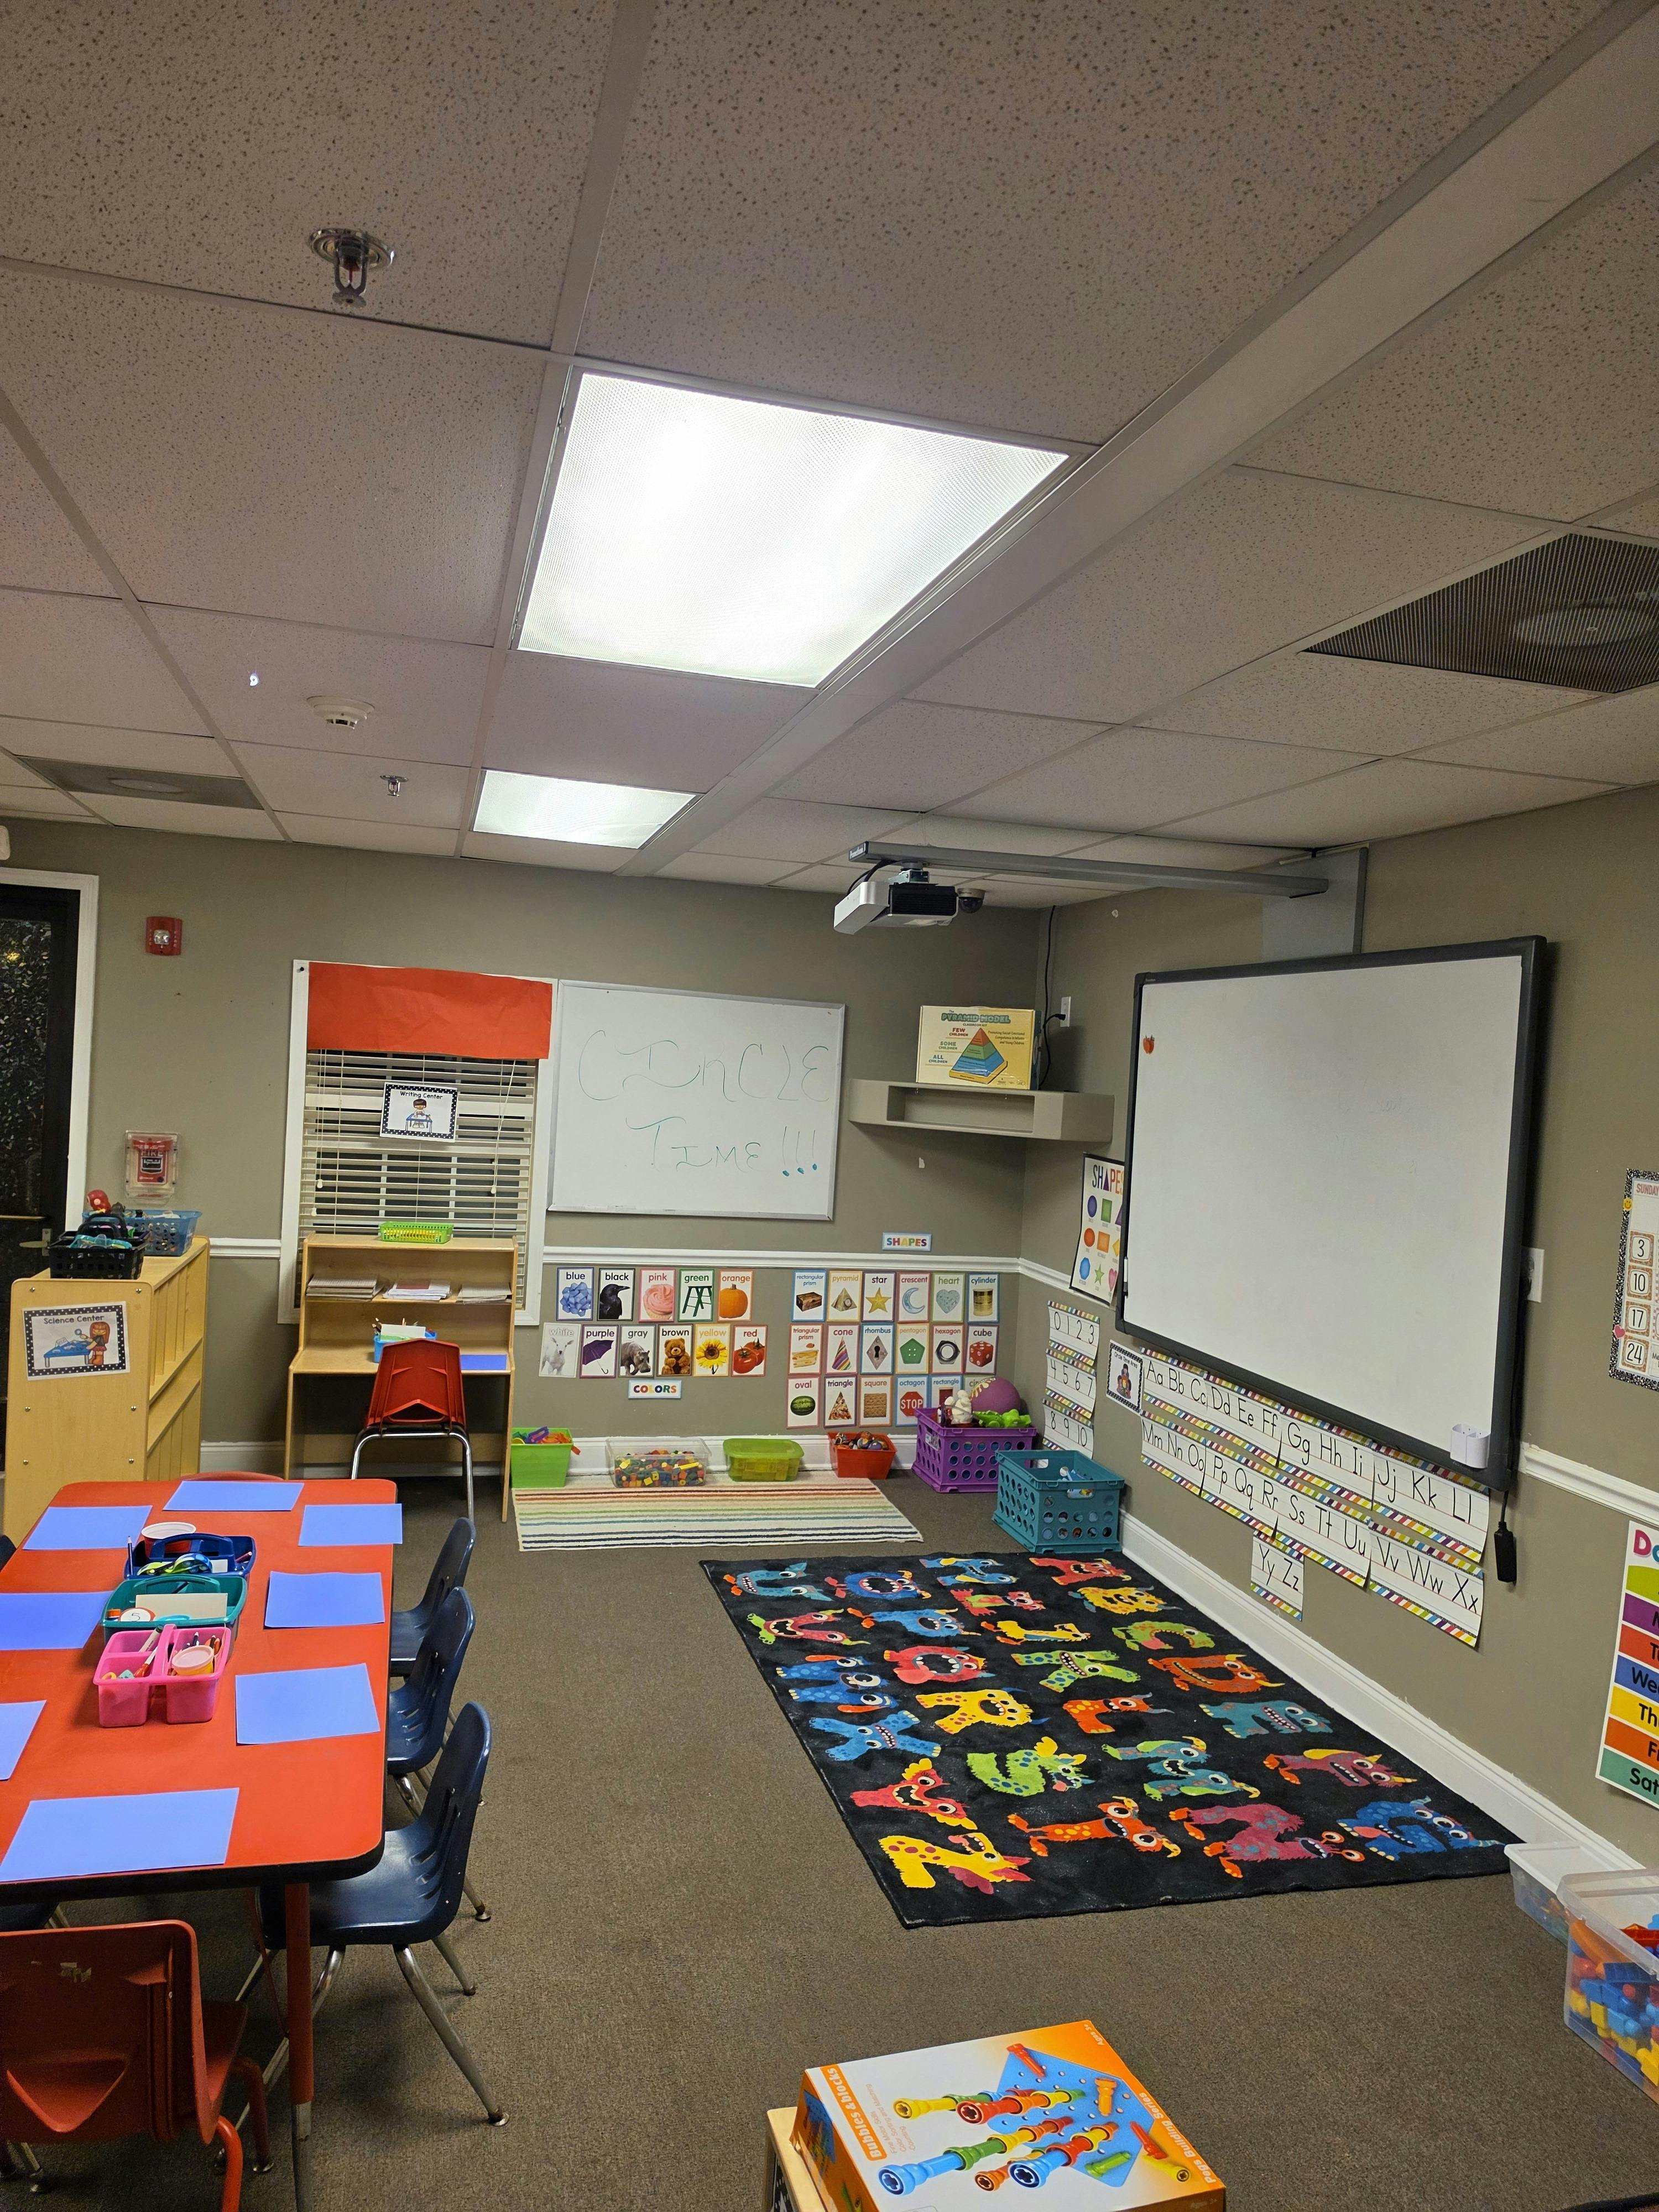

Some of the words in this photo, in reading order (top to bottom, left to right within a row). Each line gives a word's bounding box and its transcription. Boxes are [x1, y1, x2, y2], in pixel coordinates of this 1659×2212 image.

[941, 1013, 980, 1022] PYRAMID
[980, 1014, 1011, 1024] MODEL
[887, 1238, 927, 1247] SHAPES
[1638, 1239, 1645, 1258] 3
[566, 1272, 585, 1280] blue
[648, 1273, 667, 1283] pink
[685, 1274, 709, 1283] green
[721, 1274, 750, 1284] orange
[971, 1276, 997, 1285] cylinder
[1634, 1273, 1646, 1292] 10
[1632, 1309, 1644, 1328] 17
[549, 1328, 574, 1337] white
[586, 1329, 615, 1338] purple
[628, 1329, 648, 1338] gray
[699, 1329, 727, 1337] yellow
[1054, 1311, 1061, 1331] 0
[1067, 1315, 1070, 1335] 1
[1076, 1319, 1082, 1340] 2
[1088, 1324, 1094, 1345] 3
[1627, 1343, 1642, 1364] 24
[795, 1380, 812, 1389] oval
[827, 1380, 853, 1388] triangle
[899, 1379, 925, 1387] octagon
[1051, 1360, 1056, 1379] 4
[1063, 1365, 1068, 1385] 5
[1075, 1371, 1081, 1391] 6
[1087, 1376, 1094, 1397] 7
[634, 1385, 676, 1394] COLORS
[900, 1399, 924, 1410] STOP
[1051, 1411, 1056, 1430] 8
[1064, 1418, 1070, 1438] 9
[1077, 1424, 1087, 1447] 10
[1147, 1360, 1163, 1385] Aa
[1168, 1368, 1184, 1395] Bb
[1191, 1378, 1206, 1405] Cc
[1211, 1386, 1230, 1416] Dd
[1238, 1397, 1254, 1427] Ee
[1262, 1408, 1278, 1437] Ff
[1287, 1422, 1310, 1466] Gg
[1321, 1433, 1342, 1468] Hh
[1353, 1447, 1363, 1477] Ii
[1377, 1460, 1396, 1503] Jj
[1412, 1470, 1437, 1509] Kk
[1452, 1487, 1471, 1525] Ll
[1142, 1421, 1162, 1450] Mm
[1168, 1432, 1182, 1460] Nn
[1188, 1443, 1204, 1471] Oo
[1213, 1455, 1228, 1494] Pp
[1235, 1468, 1254, 1511] Qq
[1262, 1480, 1279, 1510] Rr
[1288, 1494, 1305, 1525] Ss
[1315, 1504, 1332, 1538] Tt
[1344, 1519, 1366, 1557] Uu
[1377, 1536, 1399, 1572] Vv
[1406, 1550, 1443, 1595] Ww
[1452, 1573, 1478, 1614] Xx
[1259, 1544, 1275, 1586] Yy
[1284, 1557, 1298, 1592] Zz
[129, 1613, 140, 1622] 5
[1084, 2024, 1095, 2034] 3+
[1093, 2033, 1105, 2046] Ages
[827, 2068, 852, 2104] blocks
[866, 2084, 880, 2106] Matching
[878, 2107, 888, 2117] and
[1139, 2092, 1164, 2120] Series
[870, 2111, 881, 2125] Skills
[885, 2117, 898, 2136] Sorting
[852, 2112, 883, 2158] Bubbles
[879, 2126, 891, 2141] Motor
[899, 2126, 916, 2150] Counting
[1161, 2120, 1196, 2158] Building
[888, 2141, 897, 2154] Fine
[896, 2138, 906, 2152] Color
[1193, 2159, 1217, 2183] Pegs
